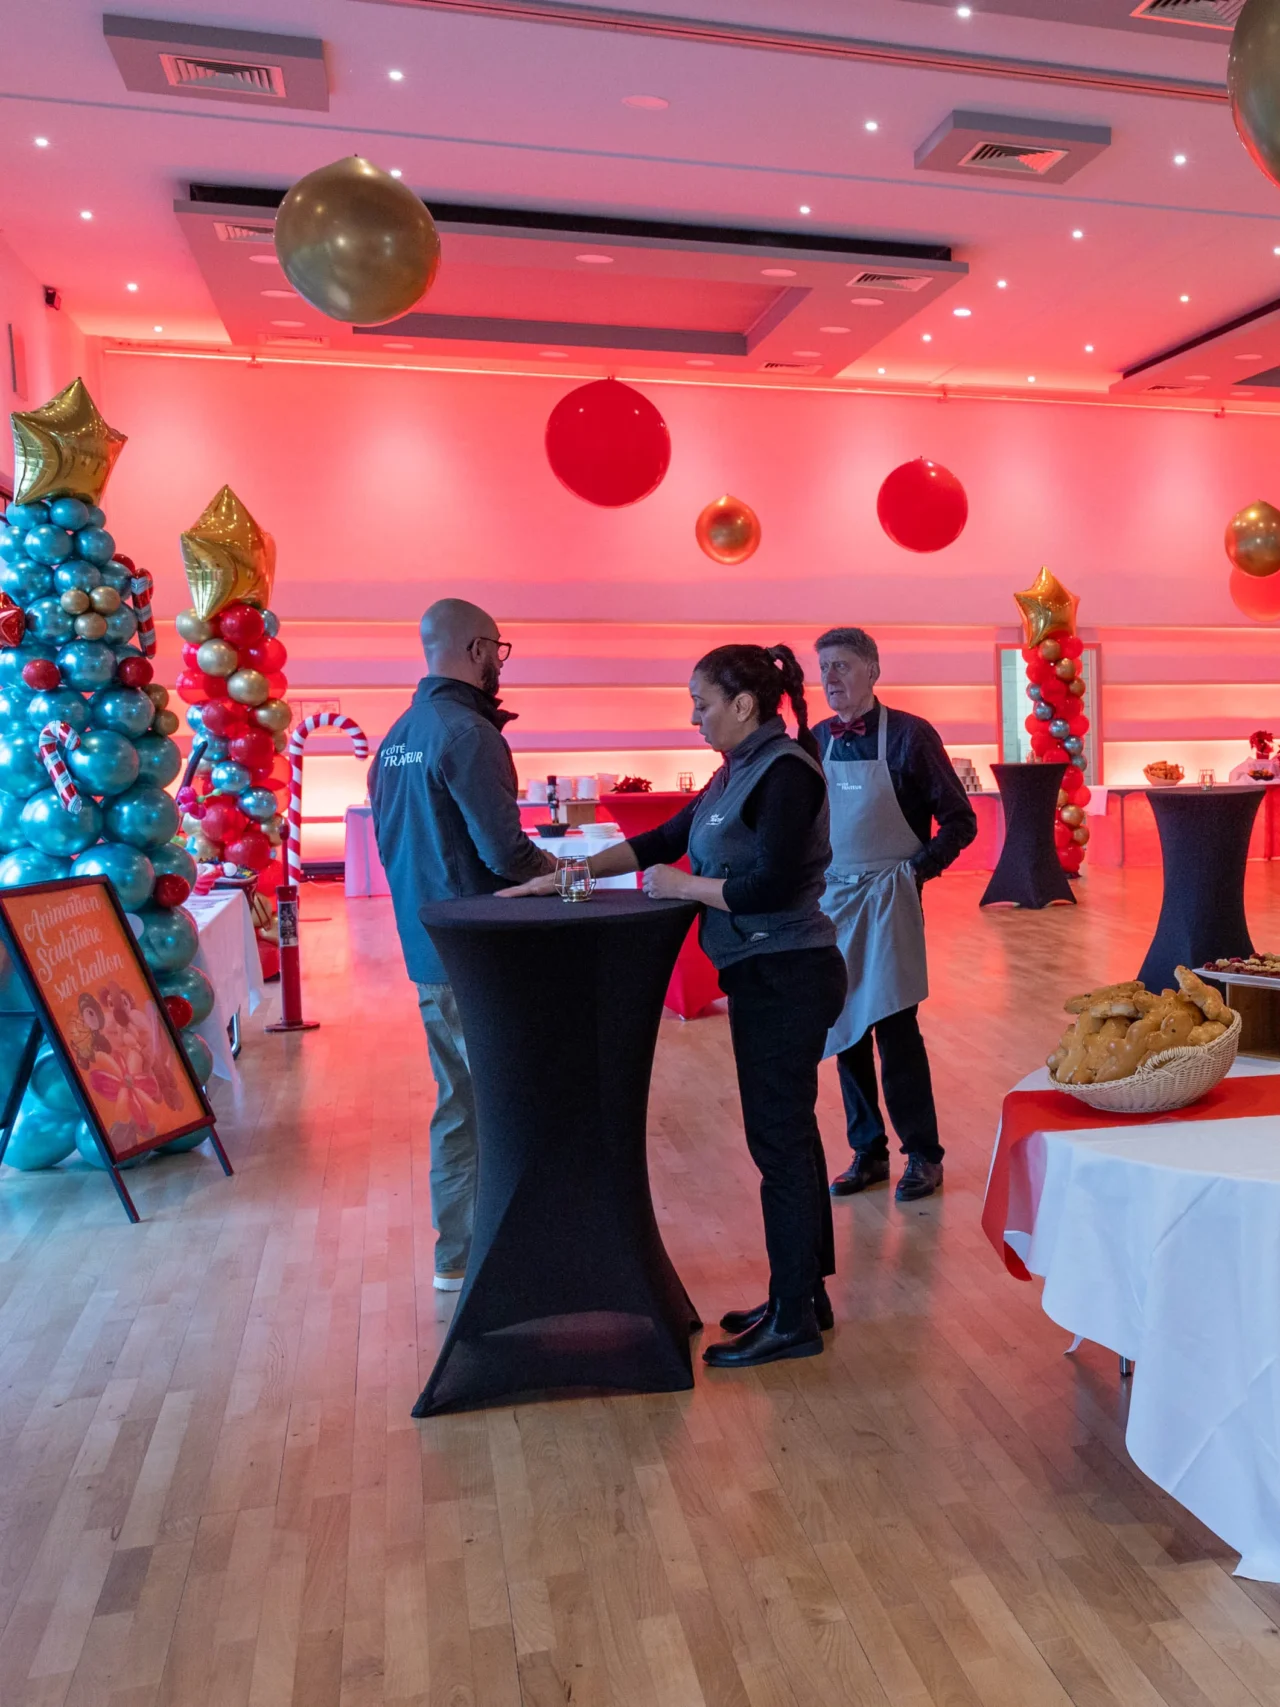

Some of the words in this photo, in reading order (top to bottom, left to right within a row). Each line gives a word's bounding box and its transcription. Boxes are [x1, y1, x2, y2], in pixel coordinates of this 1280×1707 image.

[23, 893, 101, 946] Animation
[36, 924, 103, 984] Sculpture
[54, 974, 79, 1003] sur
[77, 949, 125, 987] ballon
